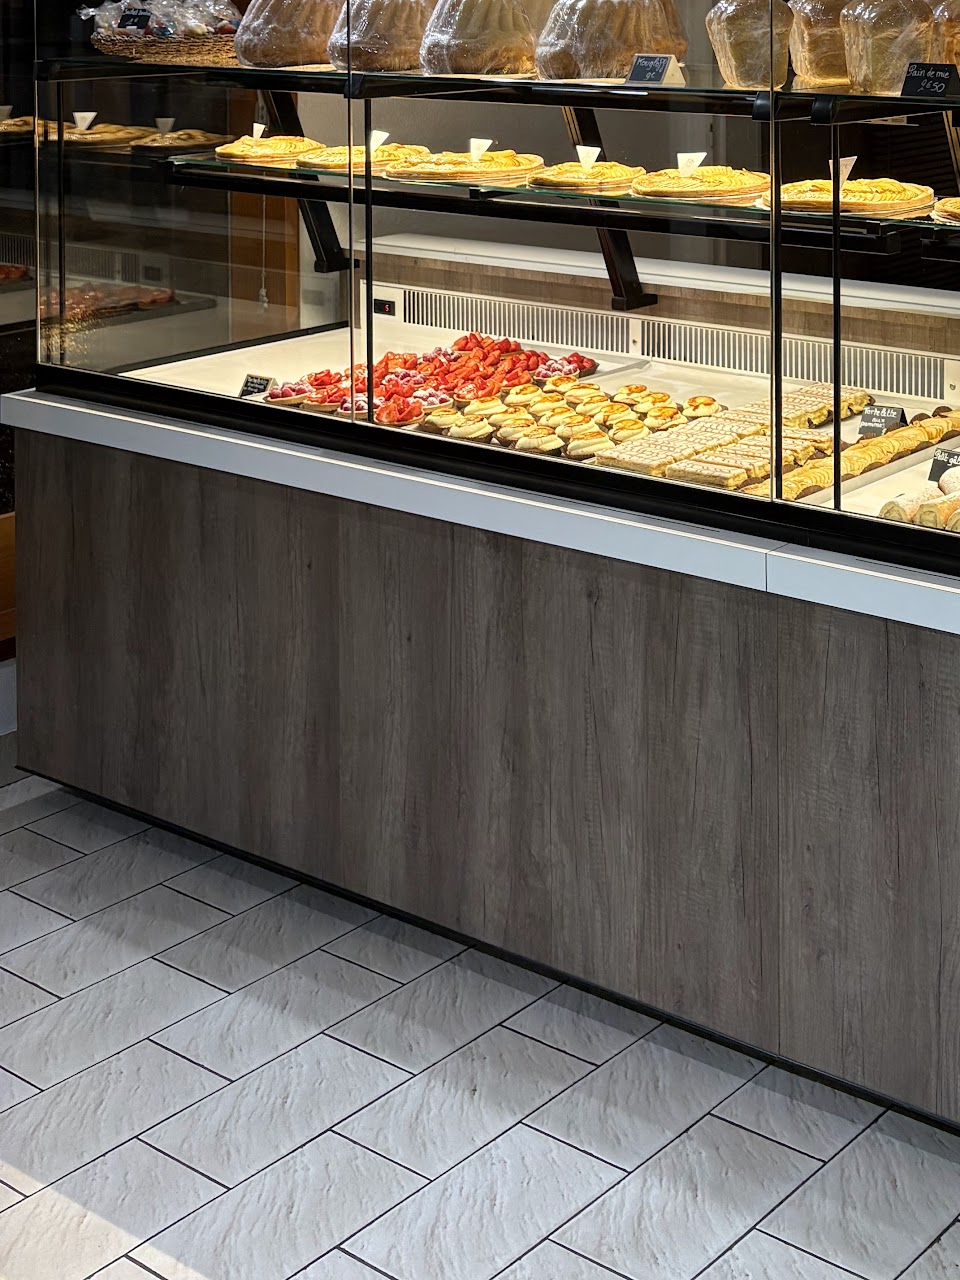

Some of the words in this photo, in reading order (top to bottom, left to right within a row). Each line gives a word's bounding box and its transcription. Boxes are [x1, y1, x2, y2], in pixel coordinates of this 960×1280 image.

[907, 64, 926, 77] Pain
[926, 67, 935, 78] de
[935, 67, 950, 79] mie
